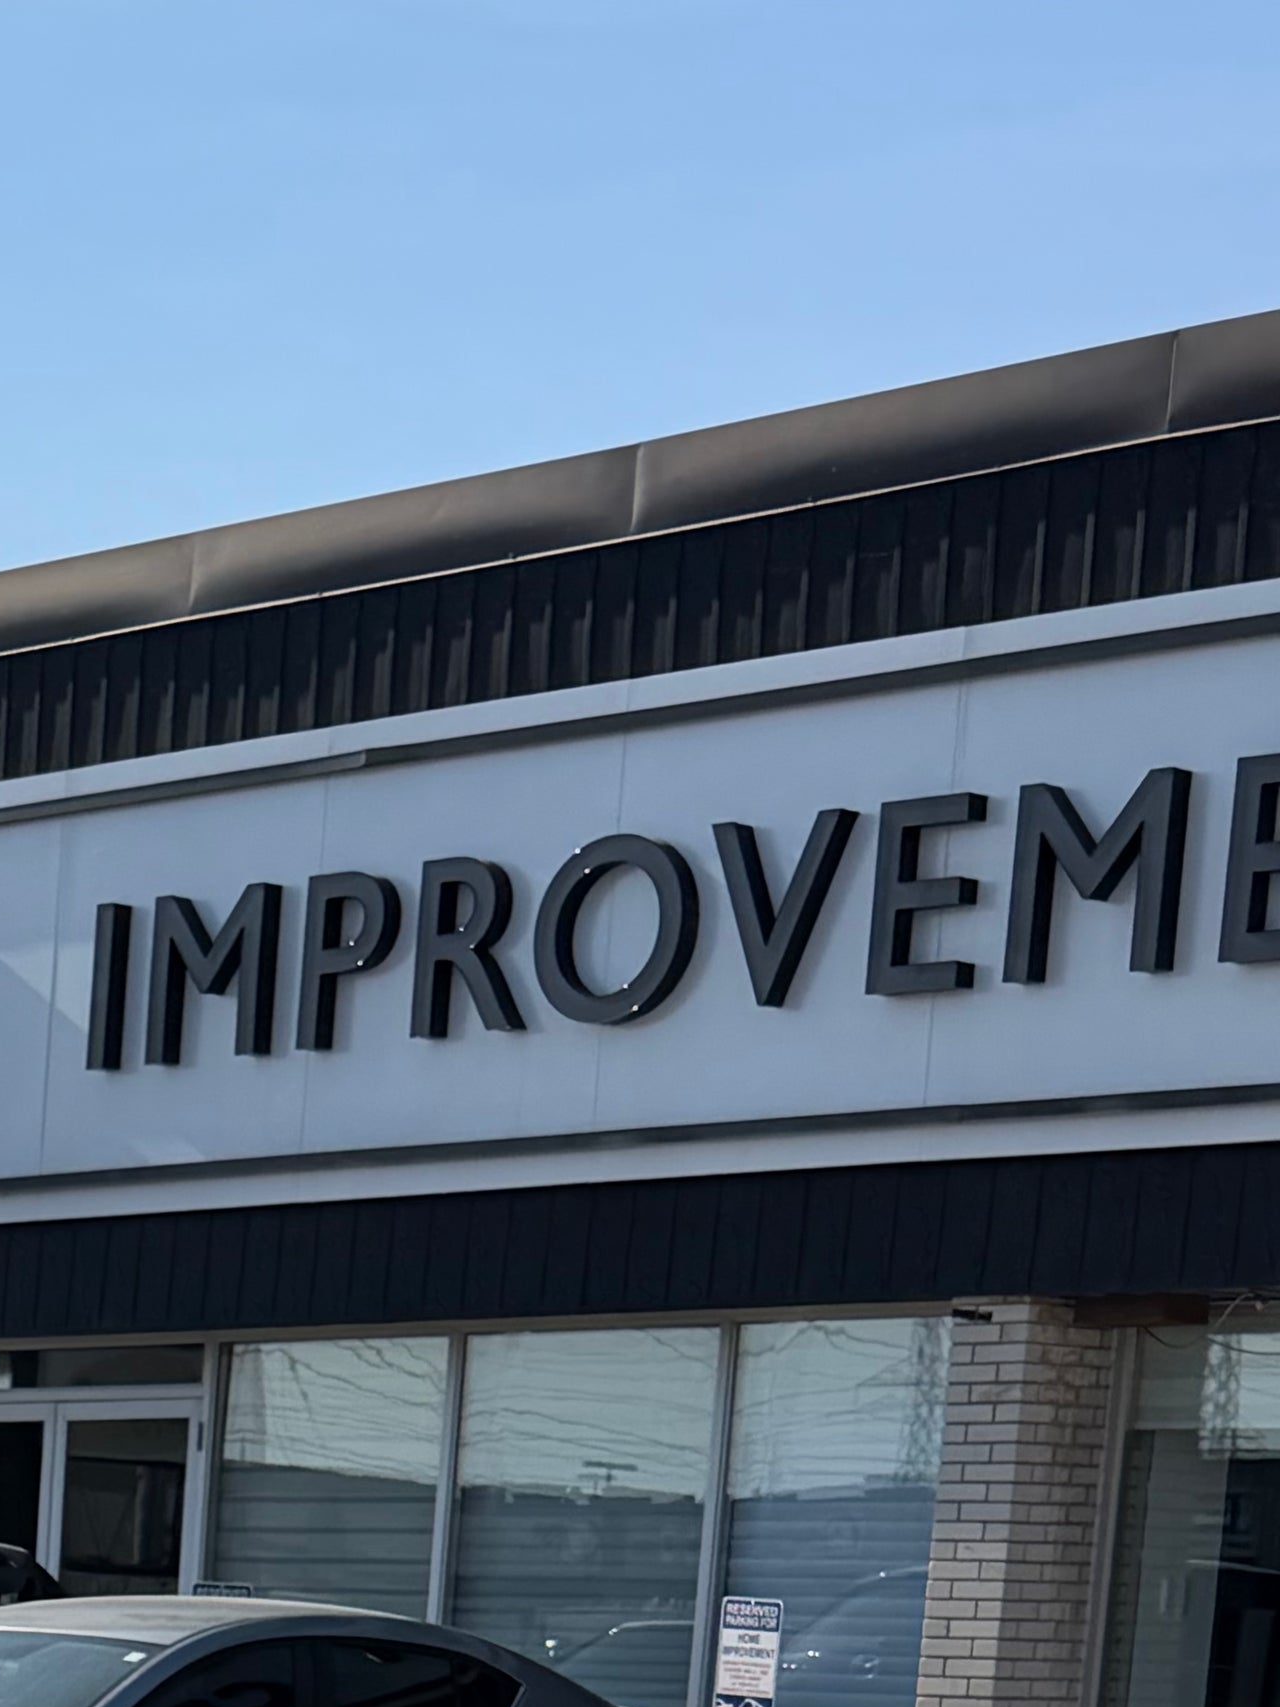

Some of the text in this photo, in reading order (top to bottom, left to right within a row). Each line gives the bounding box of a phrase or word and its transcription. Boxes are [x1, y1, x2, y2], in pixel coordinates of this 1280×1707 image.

[726, 1603, 779, 1617] RESERVED
[725, 1614, 778, 1629] PARKING FOR
[738, 1633, 760, 1645] HOME
[723, 1646, 775, 1660] IMPROVEMENT
